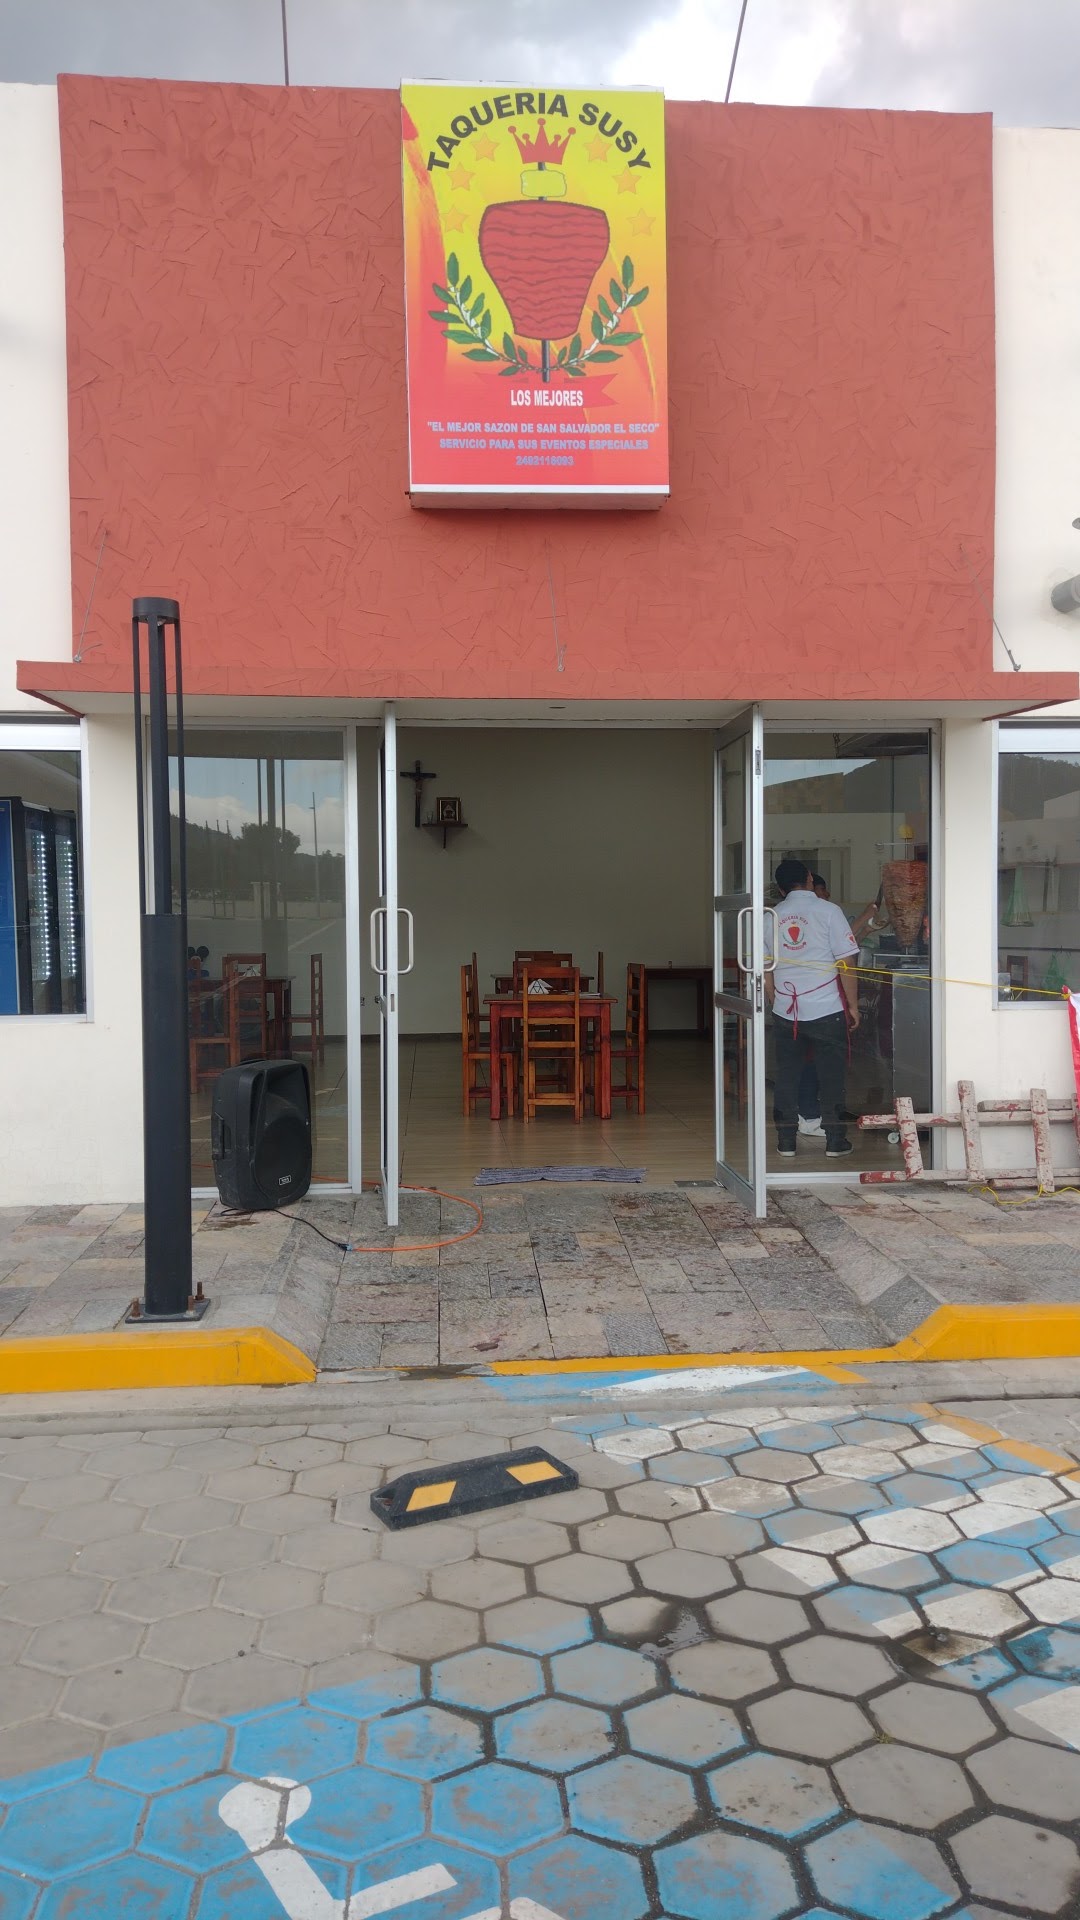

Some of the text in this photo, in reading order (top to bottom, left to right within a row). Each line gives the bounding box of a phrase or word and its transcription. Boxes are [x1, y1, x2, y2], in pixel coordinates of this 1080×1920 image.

[427, 92, 652, 172] TAQUERIA SUSY
[510, 389, 583, 407] LOS MEJORES
[427, 421, 660, 434] "EL MEJOR SAZON DE SAN SALVADOR EL SECO"
[440, 438, 649, 450] SERVICIO PARA SUS EVENTOS ESPECIALES
